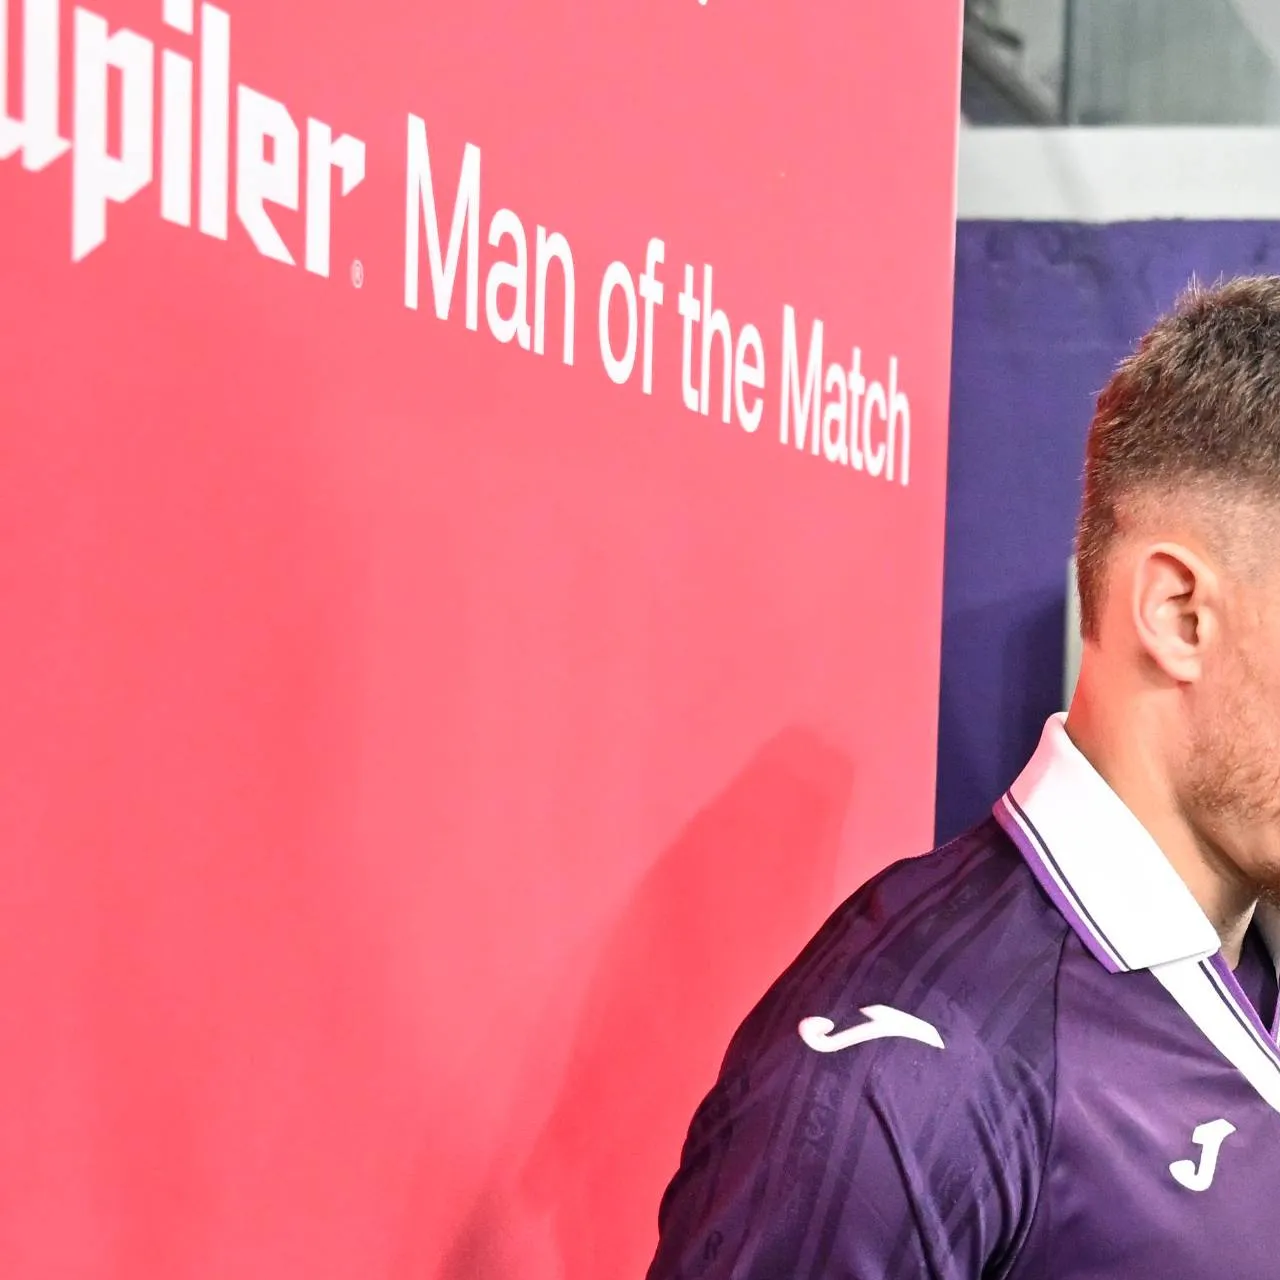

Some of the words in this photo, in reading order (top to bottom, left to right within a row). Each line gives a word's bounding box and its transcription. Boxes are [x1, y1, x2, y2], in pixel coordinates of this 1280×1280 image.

[404, 112, 577, 366] Man
[599, 237, 665, 395] of
[678, 263, 766, 433] the
[779, 304, 911, 487] Match
